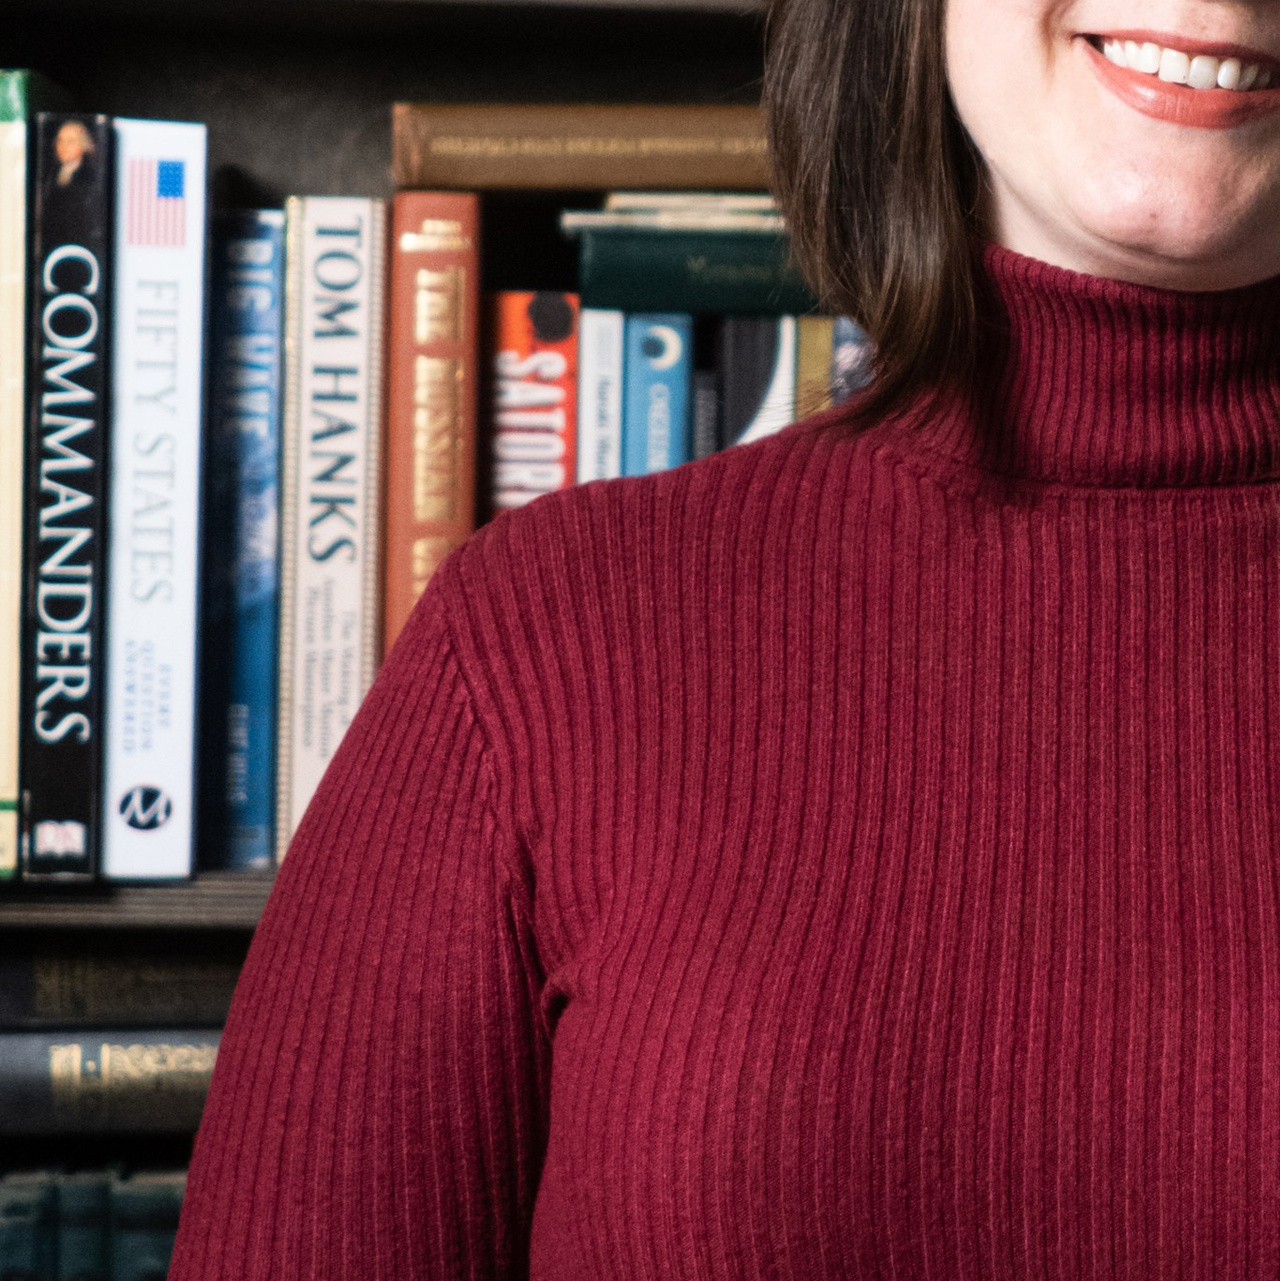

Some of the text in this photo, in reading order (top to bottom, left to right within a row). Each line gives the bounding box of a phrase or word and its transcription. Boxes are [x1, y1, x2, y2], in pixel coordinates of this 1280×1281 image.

[34, 243, 101, 745] COMMANDERS
[131, 277, 180, 604] FIFTY STATES
[309, 214, 364, 564] TOM HANKS
